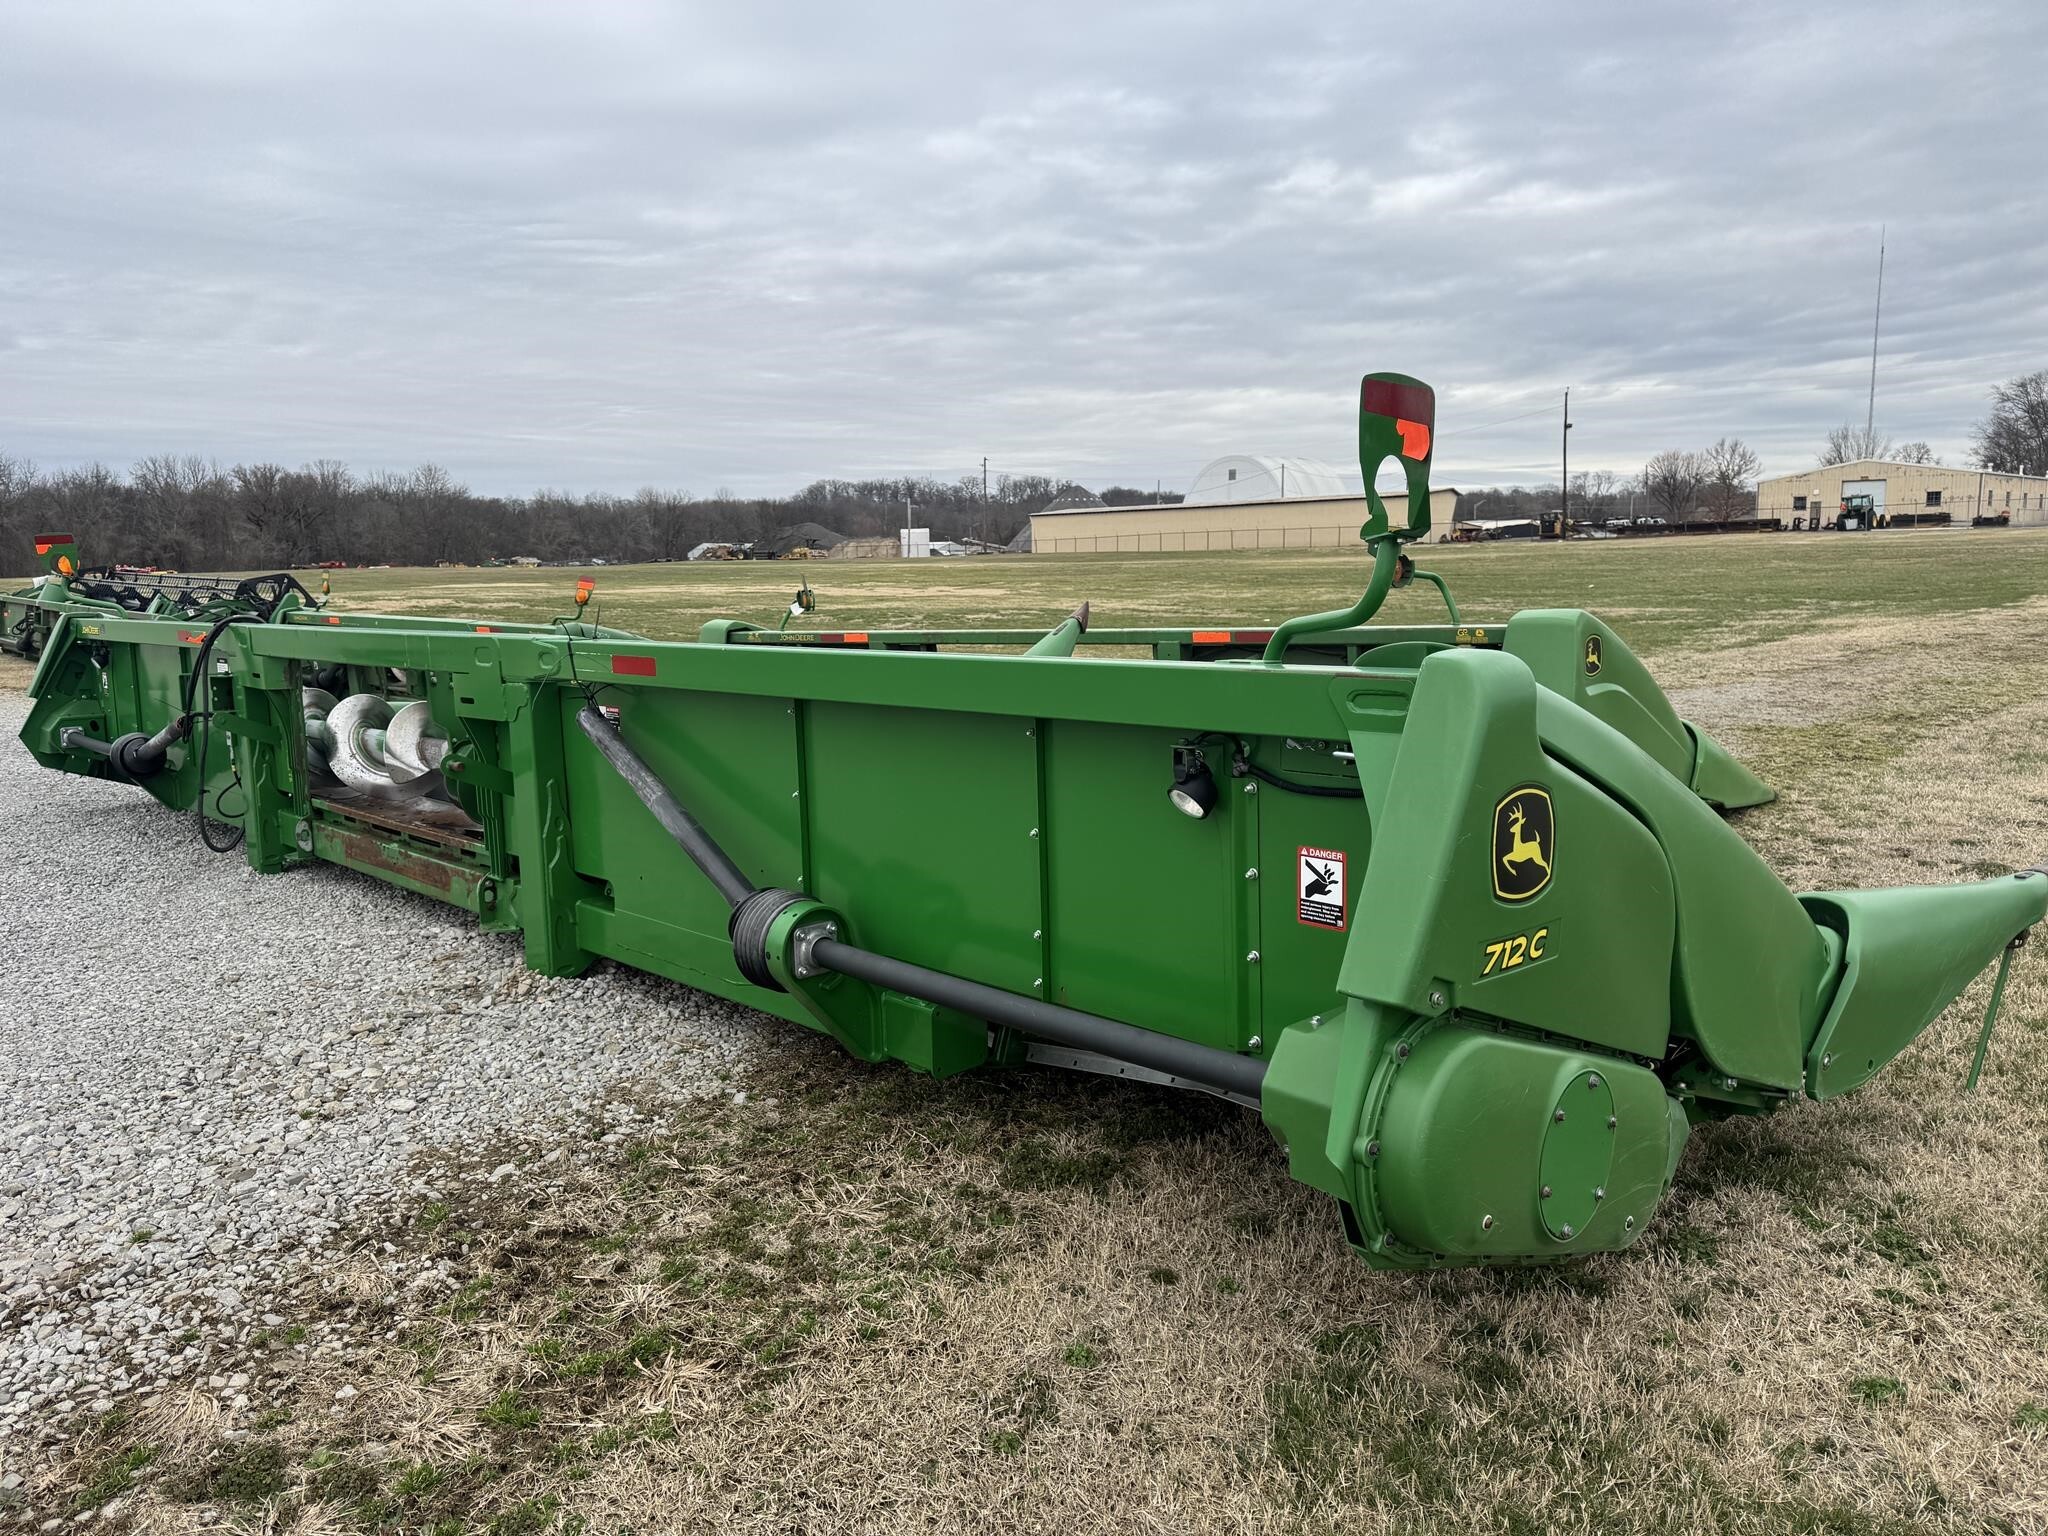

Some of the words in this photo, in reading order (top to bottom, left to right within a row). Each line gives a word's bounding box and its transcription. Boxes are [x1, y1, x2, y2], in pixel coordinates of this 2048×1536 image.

[780, 633, 796, 641] JOHN
[796, 633, 815, 641] DEERE
[1309, 848, 1343, 861] DANGER
[1482, 928, 1548, 975] 712C
